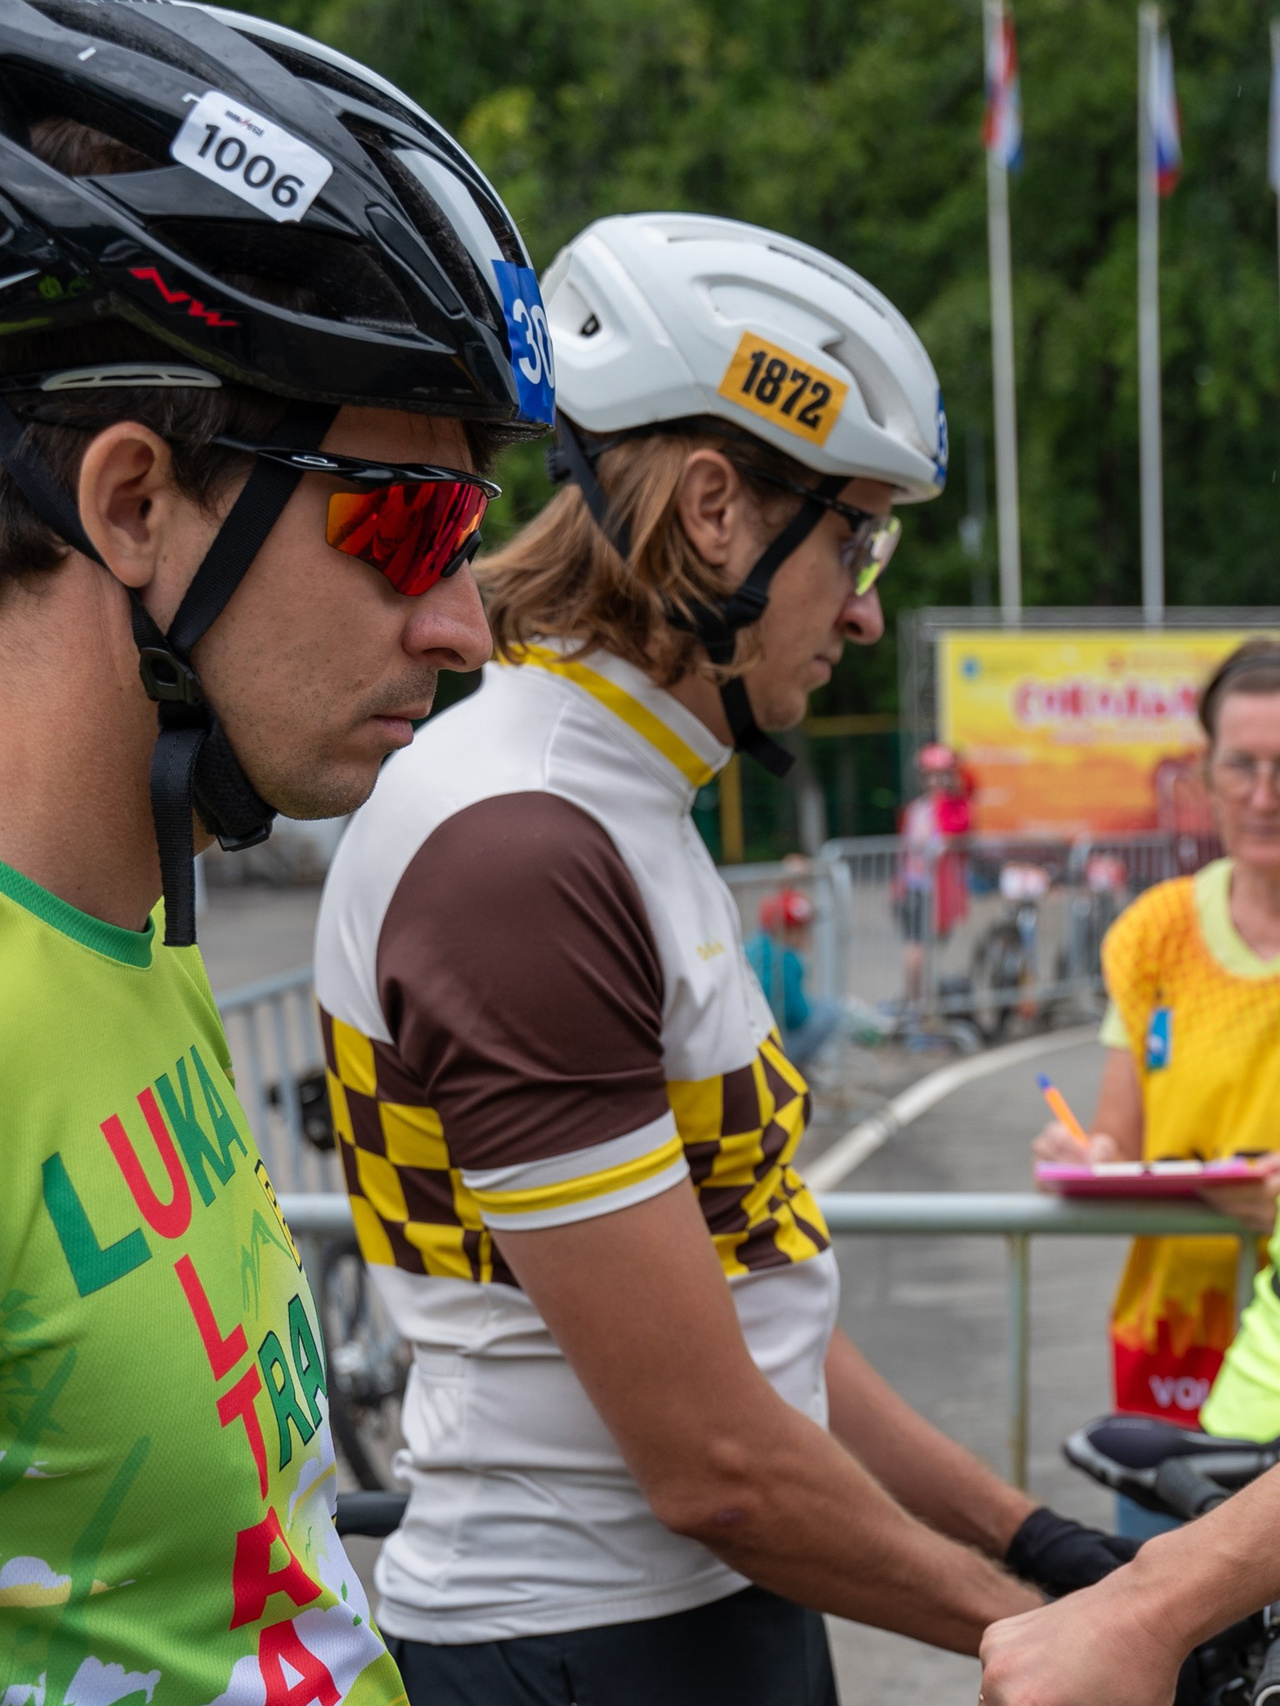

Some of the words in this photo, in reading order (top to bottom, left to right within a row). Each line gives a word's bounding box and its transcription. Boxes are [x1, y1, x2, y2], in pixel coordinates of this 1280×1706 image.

[197, 123, 305, 209] 1006
[741, 350, 833, 431] 1872
[42, 1044, 248, 1298] LUKA
